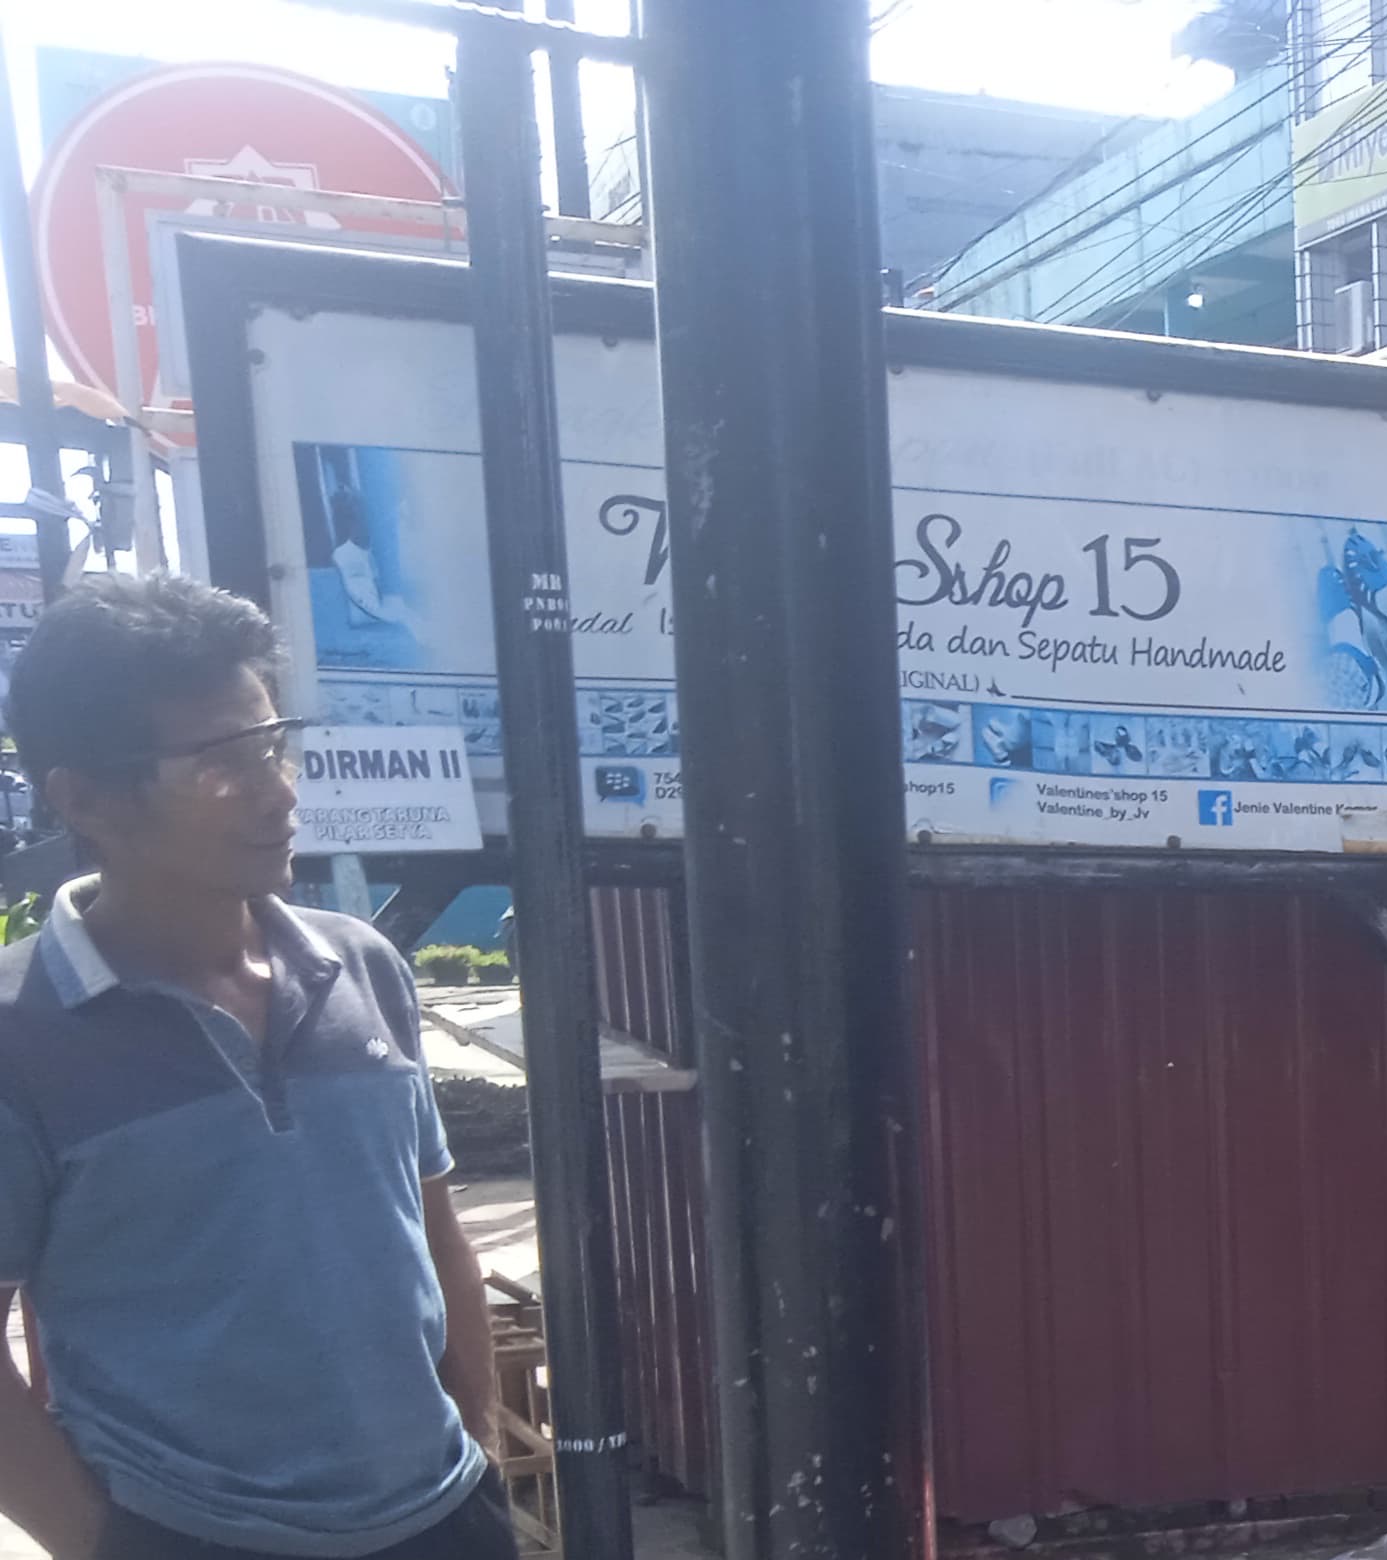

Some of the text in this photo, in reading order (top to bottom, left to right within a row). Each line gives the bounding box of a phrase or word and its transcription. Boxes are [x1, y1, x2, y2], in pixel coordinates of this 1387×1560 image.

[1081, 533, 1182, 622] 15
[897, 621, 1288, 673] da dan Sepatu Handmade
[900, 669, 980, 693] IGINAL)
[300, 749, 462, 780] DIRMAN II
[1151, 789, 1168, 802] 15
[1233, 800, 1271, 815] Jenie
[1272, 801, 1334, 816] Valentine
[315, 824, 369, 842] PILAR
